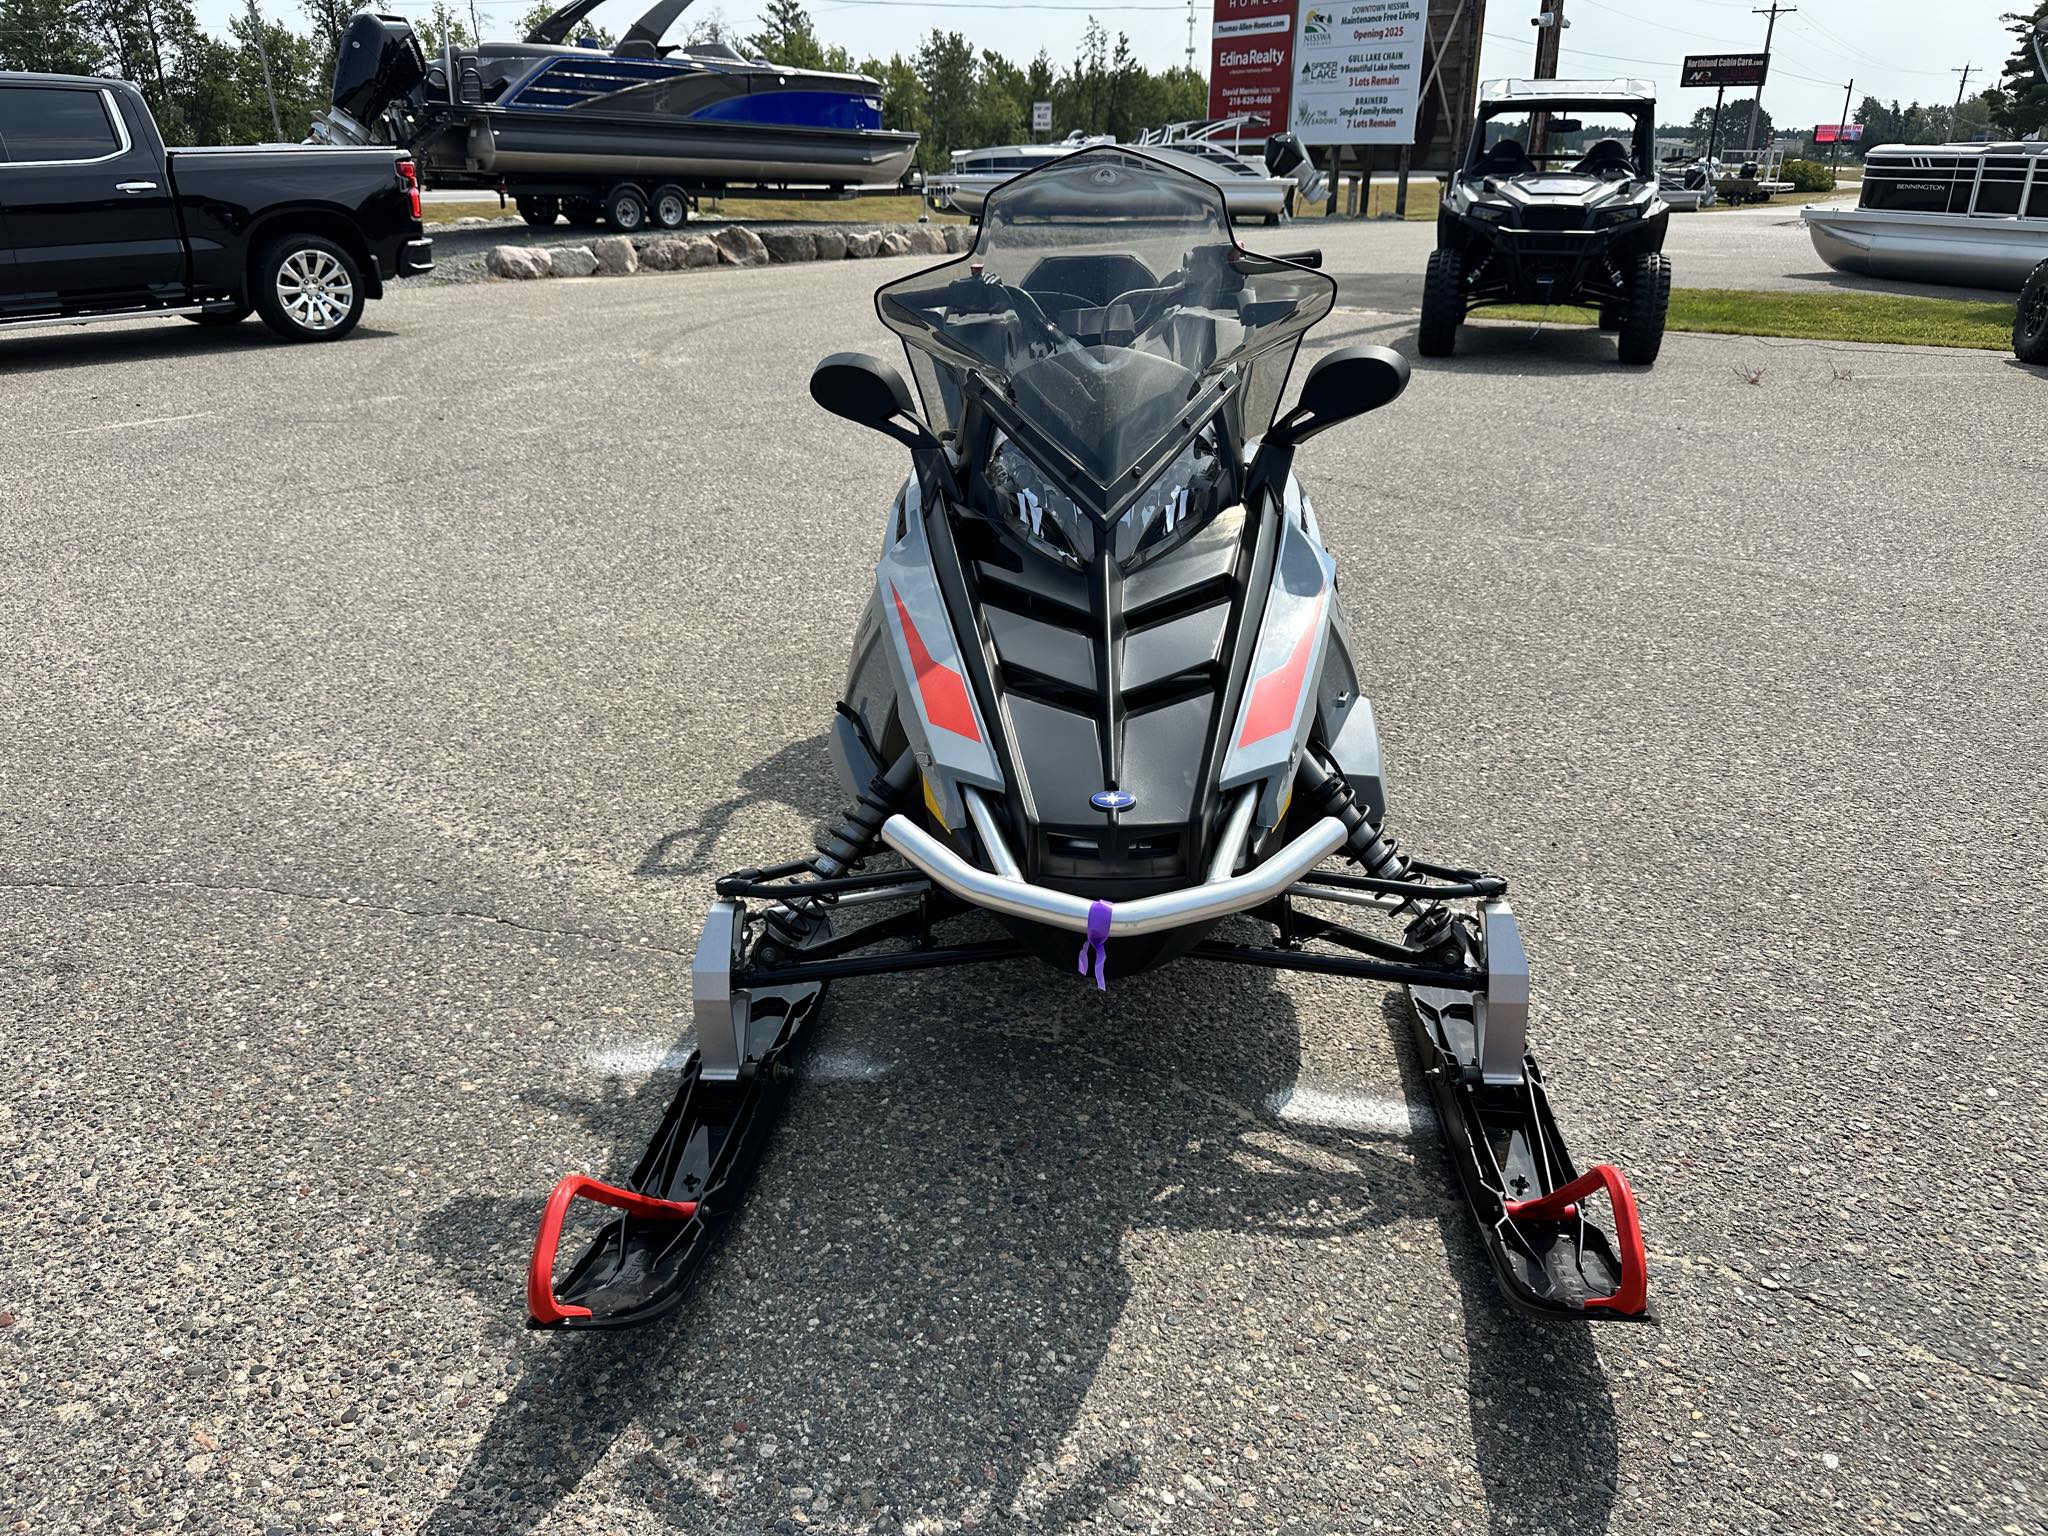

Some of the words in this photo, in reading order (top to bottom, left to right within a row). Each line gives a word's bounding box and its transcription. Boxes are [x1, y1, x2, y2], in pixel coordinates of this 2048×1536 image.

[1352, 4, 1386, 14] DOWNTOWN
[1387, 1, 1410, 10] NISSWA
[1341, 13, 1382, 25] Maintenance
[1383, 11, 1398, 21] Free
[1399, 9, 1420, 21] Living
[1304, 33, 1332, 42] NISSWA
[1353, 28, 1384, 41] Opening
[1384, 26, 1404, 37] 2025
[1348, 54, 1365, 63] GULL
[1365, 53, 1381, 62] LAKE
[1383, 51, 1403, 61] CHAIN
[1311, 62, 1338, 71] SPIDER
[1345, 64, 1373, 74] Beautiful
[1373, 63, 1388, 72] Lake
[1389, 62, 1410, 71] Homes
[1686, 58, 1718, 68] Northland
[1310, 70, 1337, 80] LAKE
[1349, 77, 1354, 87] 3
[1354, 76, 1370, 87] Lots
[1371, 74, 1400, 86] Remain
[1222, 88, 1239, 97] David
[1355, 96, 1389, 106] BRAINERD
[1339, 107, 1359, 117] Single
[1359, 106, 1380, 117] Family
[1381, 105, 1404, 115] Homes
[1346, 119, 1351, 129] 7
[1353, 119, 1368, 129] Lots
[1368, 118, 1397, 129] Remain
[1896, 183, 1946, 191] BENNINGTON
